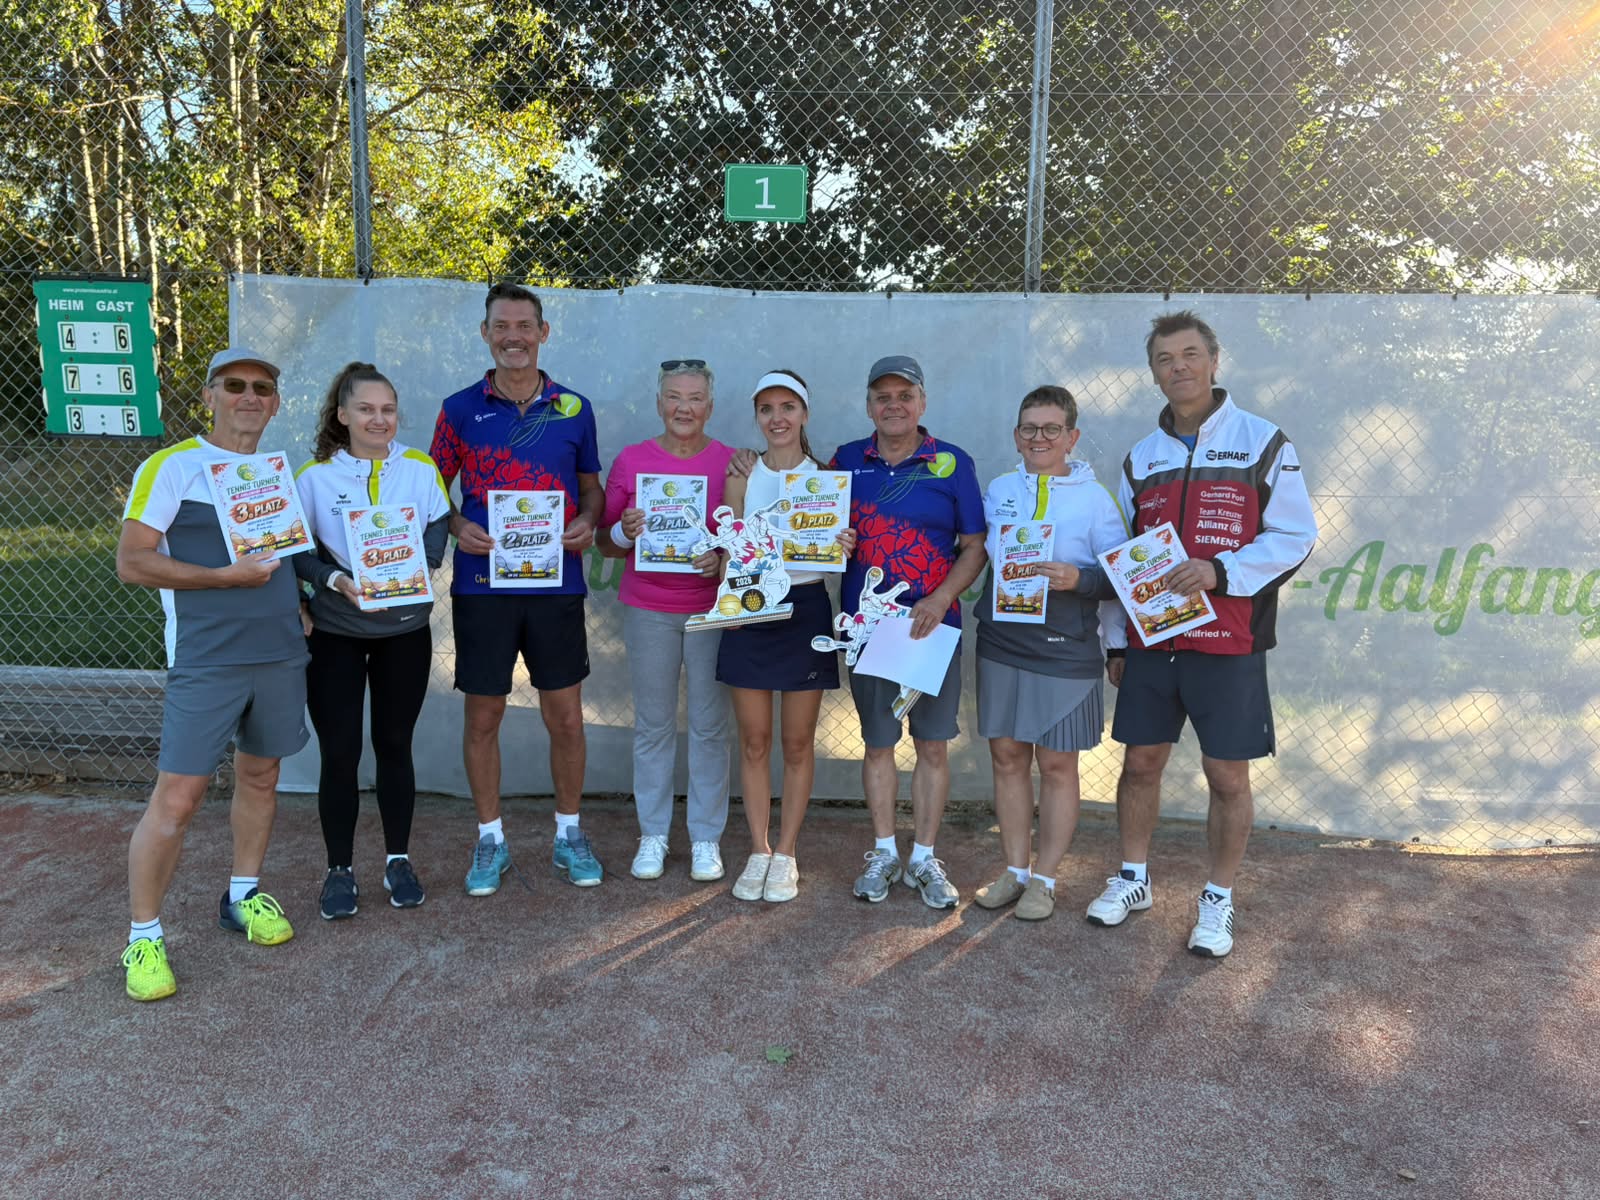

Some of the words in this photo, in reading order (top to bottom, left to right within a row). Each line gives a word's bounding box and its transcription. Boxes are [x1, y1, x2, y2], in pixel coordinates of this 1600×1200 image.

[755, 177, 776, 209] 1
[48, 299, 84, 311] HEIM
[96, 301, 134, 312] GAST
[65, 328, 75, 348] 4
[118, 329, 128, 349] 6
[68, 370, 78, 389] 7
[122, 371, 133, 390] 6
[73, 411, 82, 430] 3
[126, 413, 136, 432] 5
[226, 483, 251, 495] TENNIS
[252, 475, 280, 489] TURNIER
[792, 495, 815, 503] TENNIS
[815, 493, 840, 502] TURNIER
[236, 502, 254, 522] 3.
[254, 499, 282, 517] PLATZ
[502, 514, 525, 524] TENNIS
[527, 512, 553, 521] TURNIER
[1200, 507, 1216, 516] Team
[650, 515, 665, 532] 2.
[795, 512, 807, 528] 1.
[808, 514, 834, 527] PLATZ
[1197, 520, 1229, 531] Allianz
[360, 529, 383, 541] TENNIS
[384, 524, 410, 536] TURNIER
[504, 532, 520, 549] 2.
[521, 533, 549, 546] PLATZ
[1004, 544, 1022, 554] TENNIS
[1022, 542, 1044, 551] TURNIER
[1194, 535, 1240, 548] SIEMENS
[367, 549, 383, 568] 3.
[383, 547, 409, 562] PLATZ
[1124, 563, 1146, 580] TENNIS
[1146, 548, 1173, 568] TURNIER
[1004, 562, 1016, 579] 3.
[1017, 564, 1036, 578] PLAT
[1137, 583, 1154, 602] 3.
[1184, 630, 1219, 638] Wilfried
